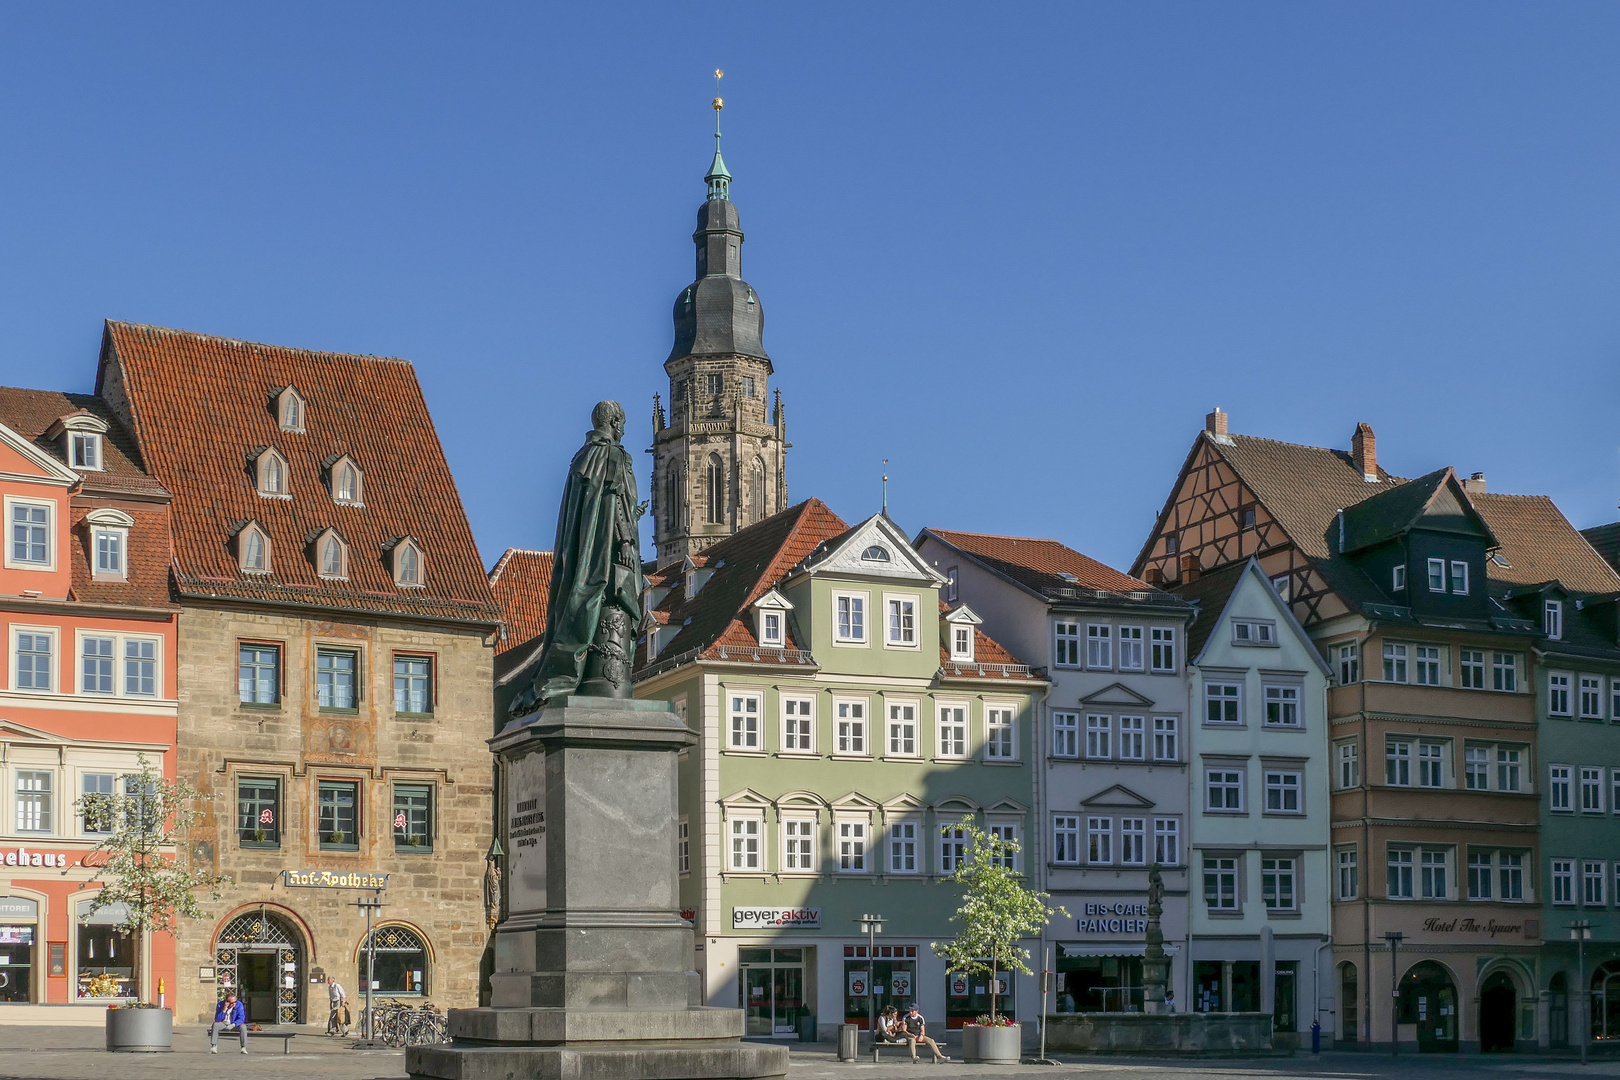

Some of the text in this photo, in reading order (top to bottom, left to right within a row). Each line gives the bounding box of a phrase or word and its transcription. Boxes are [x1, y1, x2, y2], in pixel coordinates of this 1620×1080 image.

[734, 908, 818, 924] geyer aktiv
[1077, 919, 1149, 933] PANCIER
[1423, 917, 1522, 938] Hotel The Square
